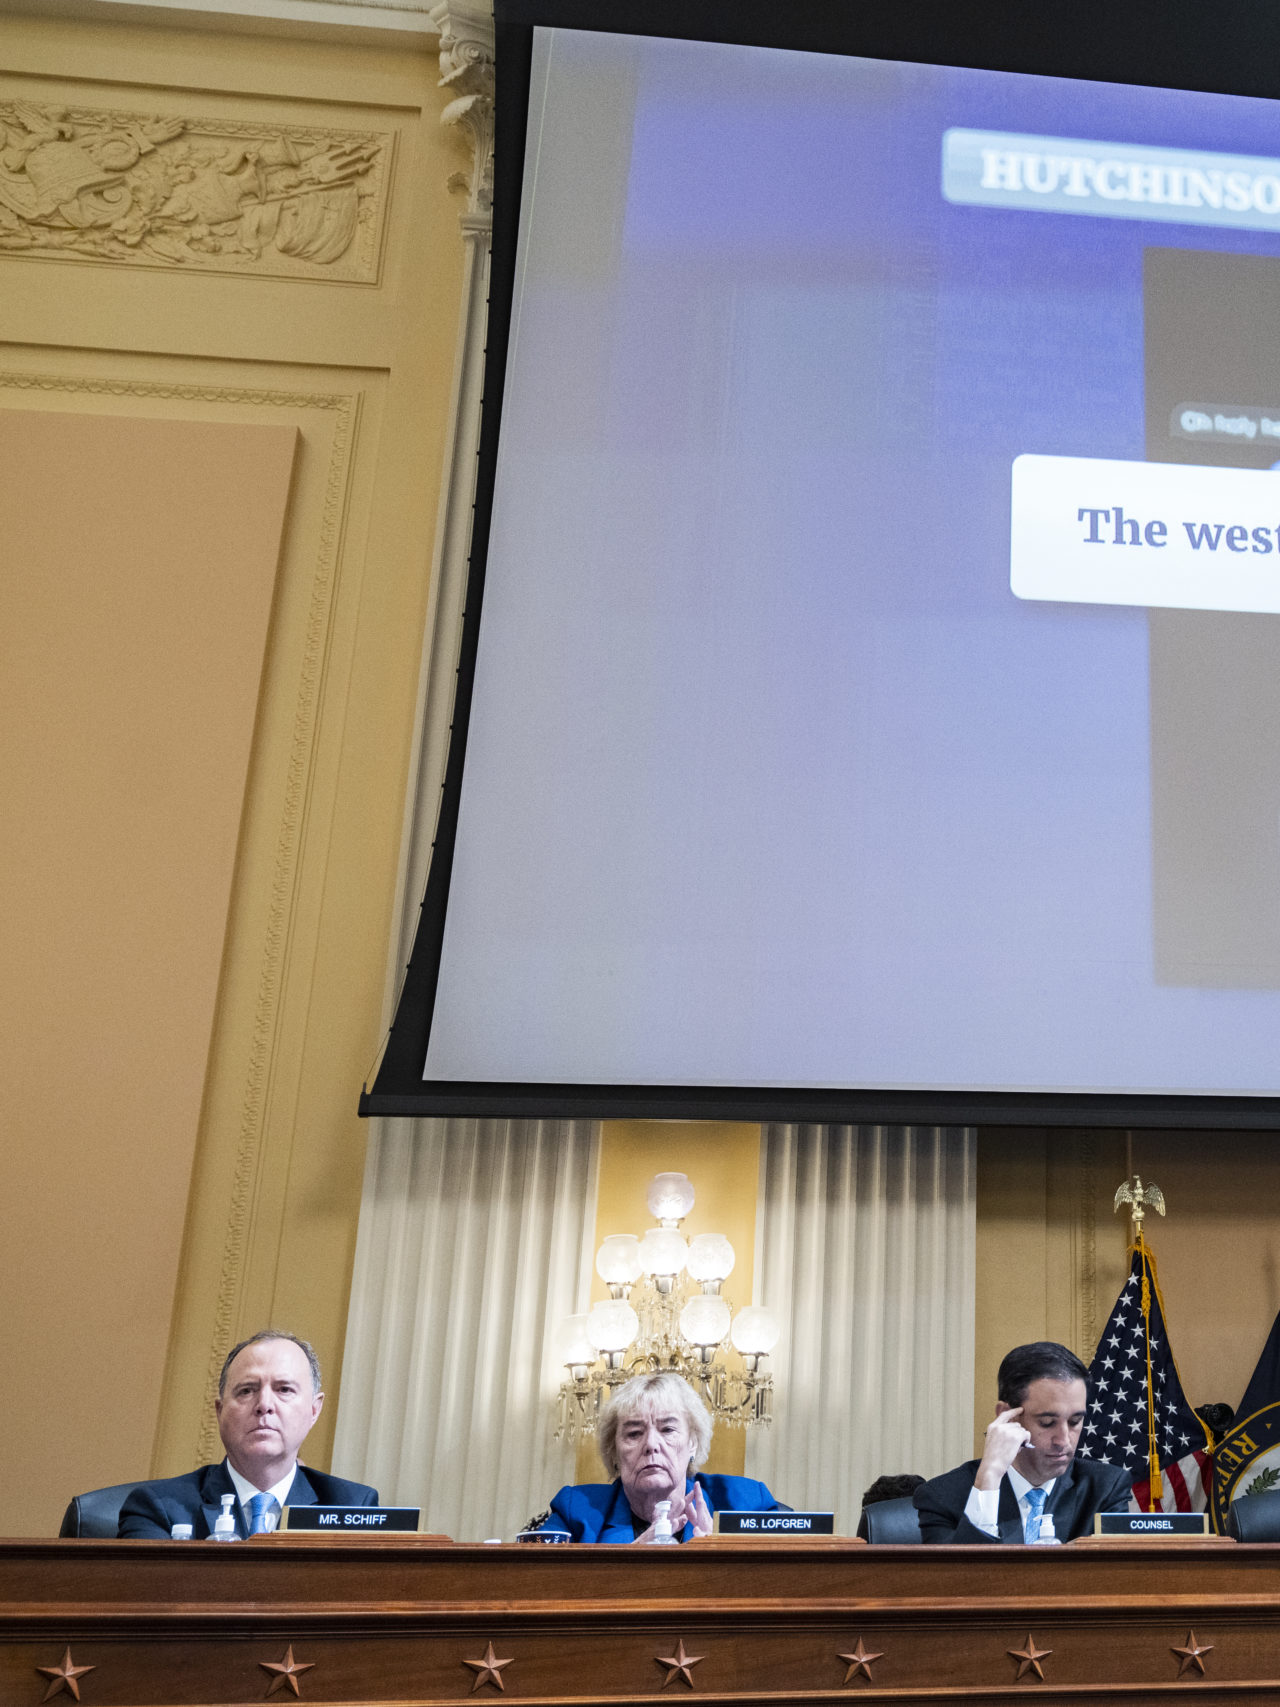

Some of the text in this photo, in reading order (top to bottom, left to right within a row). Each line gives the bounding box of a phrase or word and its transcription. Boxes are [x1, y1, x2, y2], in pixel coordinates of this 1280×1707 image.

[1077, 507, 1168, 547] The
[319, 1514, 388, 1525] MR. SCHIFF
[740, 1518, 812, 1529] MS. LOFGREN
[1130, 1520, 1174, 1530] COUNSEL
